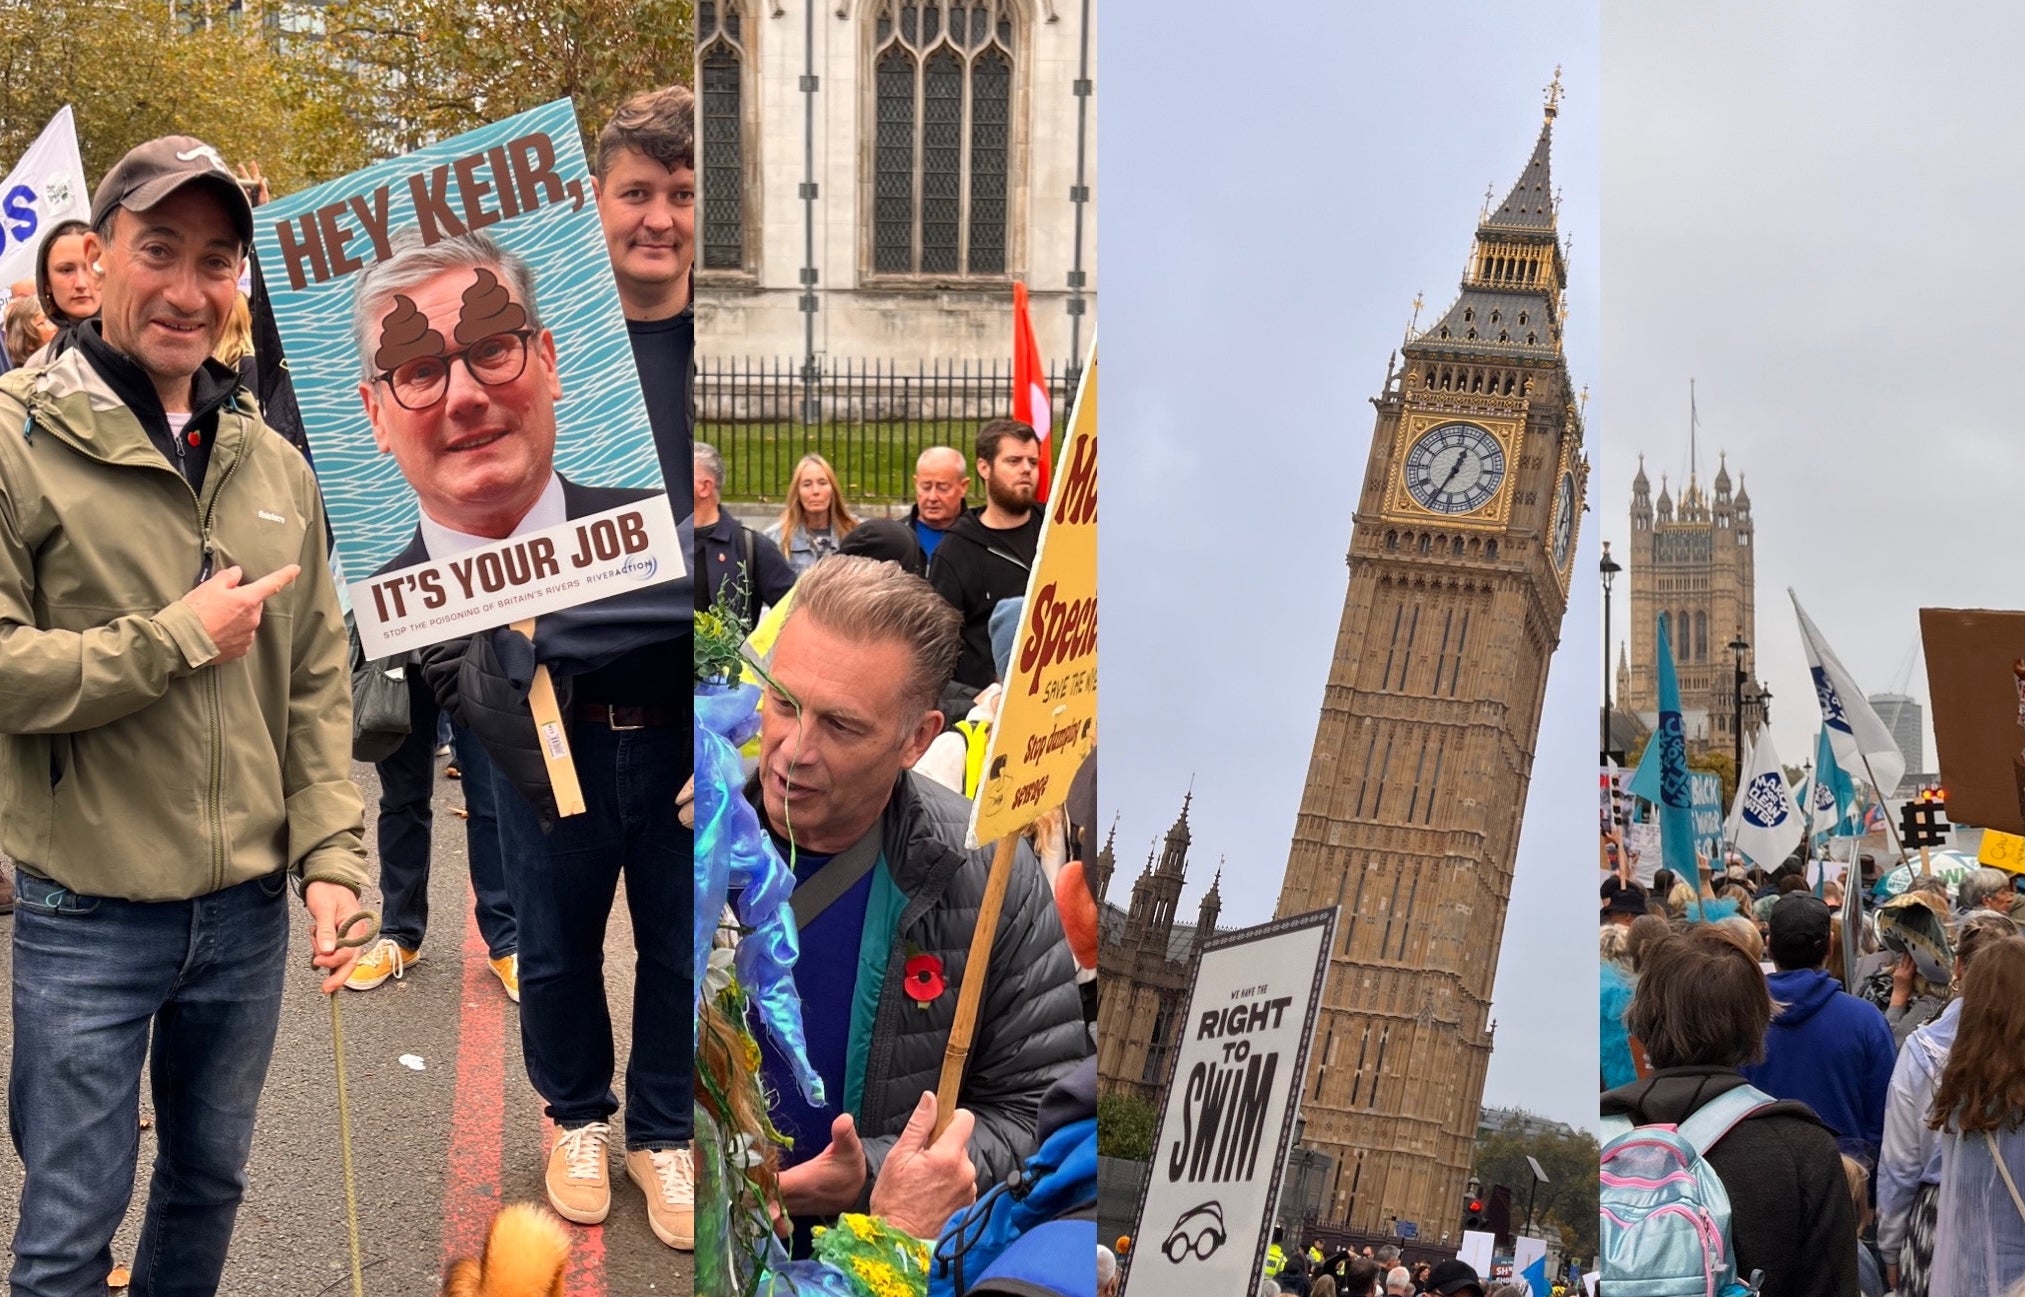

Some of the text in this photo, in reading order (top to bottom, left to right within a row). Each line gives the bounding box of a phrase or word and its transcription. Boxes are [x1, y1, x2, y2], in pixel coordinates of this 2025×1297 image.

[275, 132, 585, 291] HEY KEIR,
[371, 511, 649, 623] IT'S YOUR JOB
[383, 580, 580, 639] STOP THE POISONING OF BRITAIN'S RIVERS
[1042, 675, 1070, 703] SAVE
[1070, 669, 1087, 696] THE
[1023, 734, 1047, 767] Stop
[1011, 774, 1050, 810] sewage
[1231, 984, 1268, 1000] WE HAVE THE
[1197, 996, 1293, 1041] RIGHT
[1222, 1040, 1250, 1065] TO
[1168, 1052, 1279, 1183] SWIM
